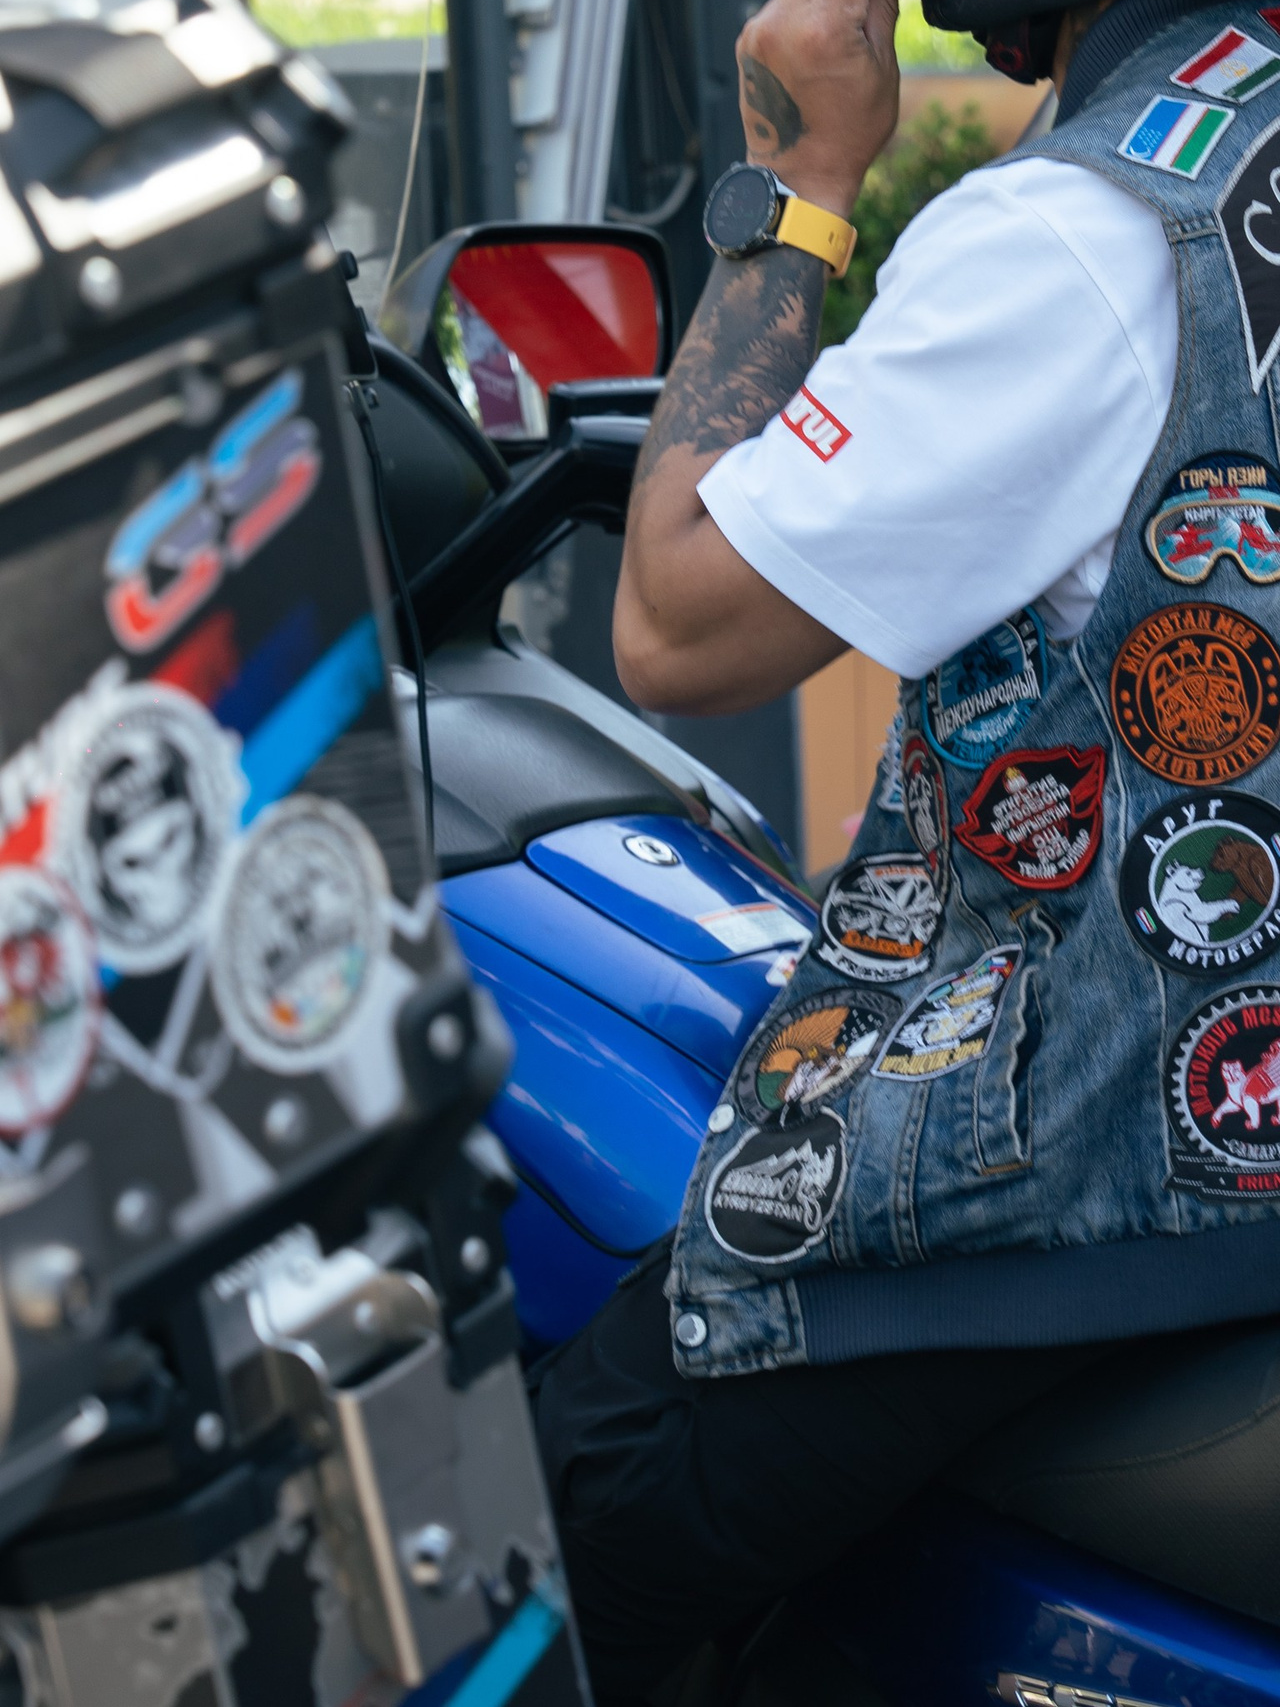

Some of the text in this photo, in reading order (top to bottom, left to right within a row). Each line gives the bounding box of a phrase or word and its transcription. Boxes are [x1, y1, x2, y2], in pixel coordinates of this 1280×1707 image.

[1180, 467, 1223, 490] ГОРЫ
[1120, 608, 1212, 676] MOTOSTAN
[934, 659, 1042, 745] МЕЖДУНАРОДНЫЙ
[1144, 722, 1274, 780] CLUB FRIEND
[1142, 798, 1224, 855] ДРУГ
